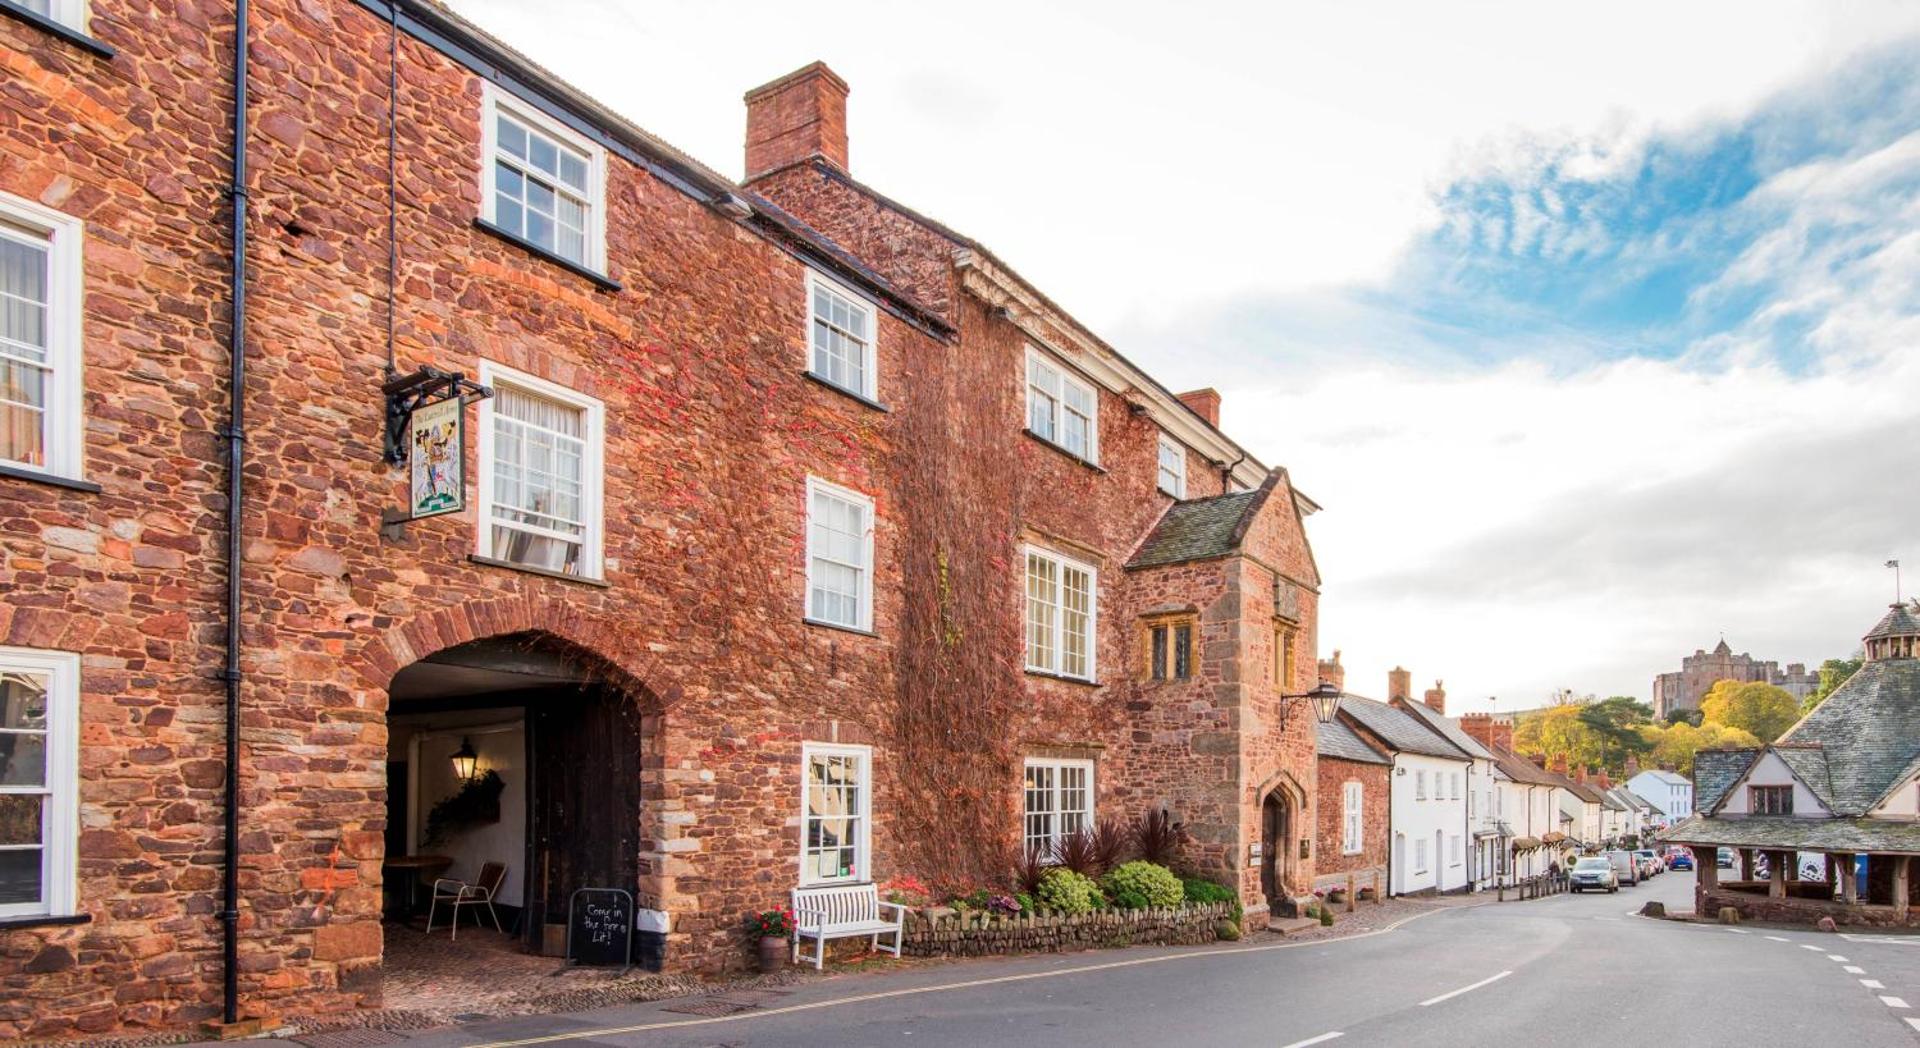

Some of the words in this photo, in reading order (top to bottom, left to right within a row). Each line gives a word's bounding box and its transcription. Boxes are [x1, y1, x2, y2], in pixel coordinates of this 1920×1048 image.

[587, 904, 610, 916] Come
[614, 904, 623, 918] in
[584, 915, 599, 930] the
